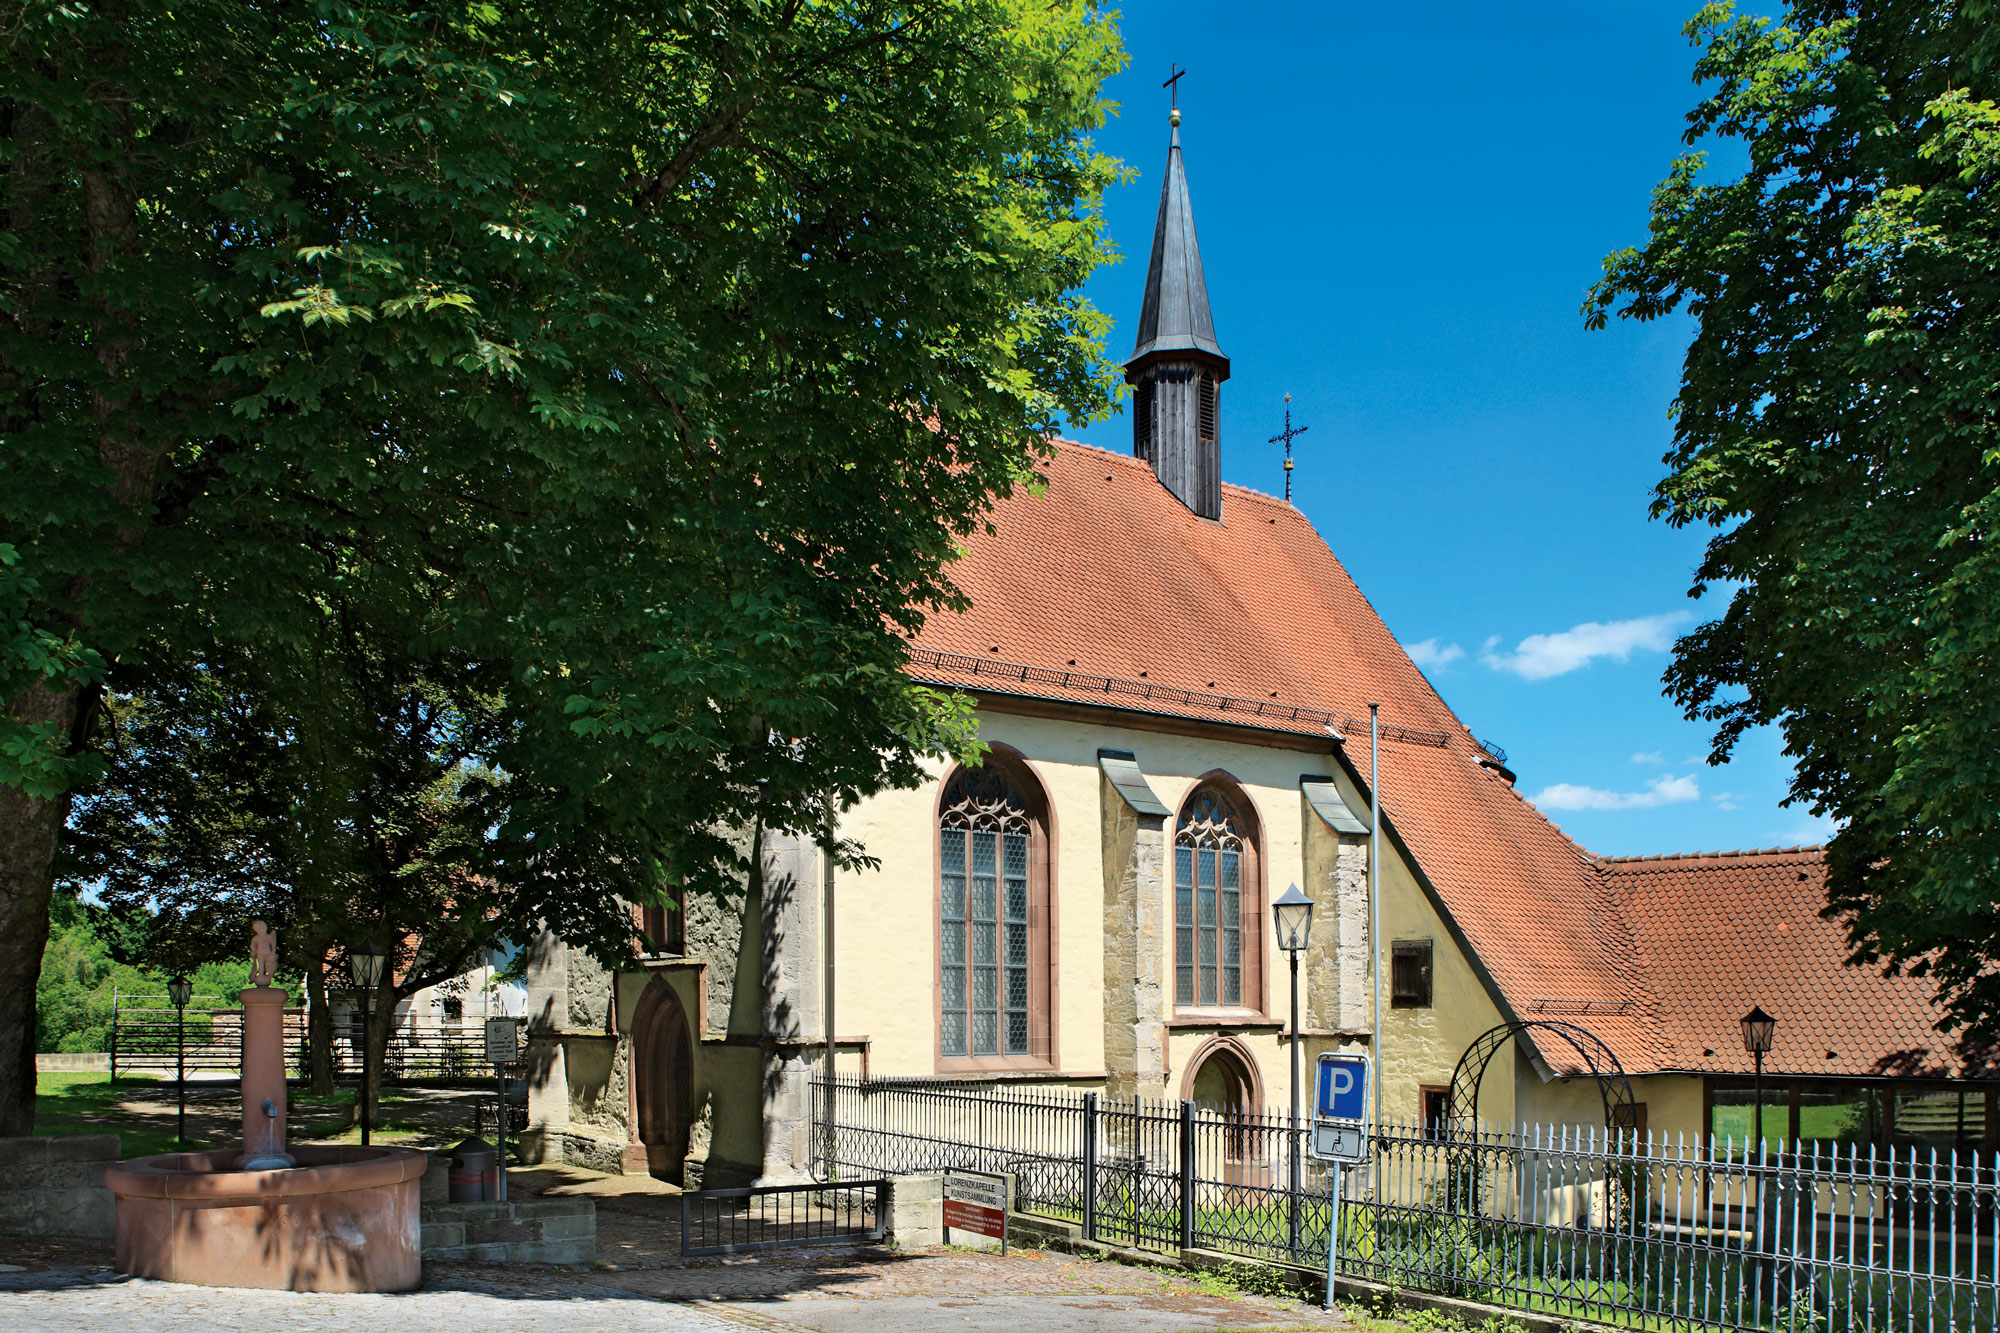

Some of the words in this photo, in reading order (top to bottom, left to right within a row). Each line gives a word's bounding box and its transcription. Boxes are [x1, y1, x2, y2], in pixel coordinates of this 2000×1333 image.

[1329, 1067, 1354, 1110] P
[951, 1177, 996, 1193] LORENZKAPELLE
[951, 1189, 997, 1206] KUNSTSAMMLUNG
